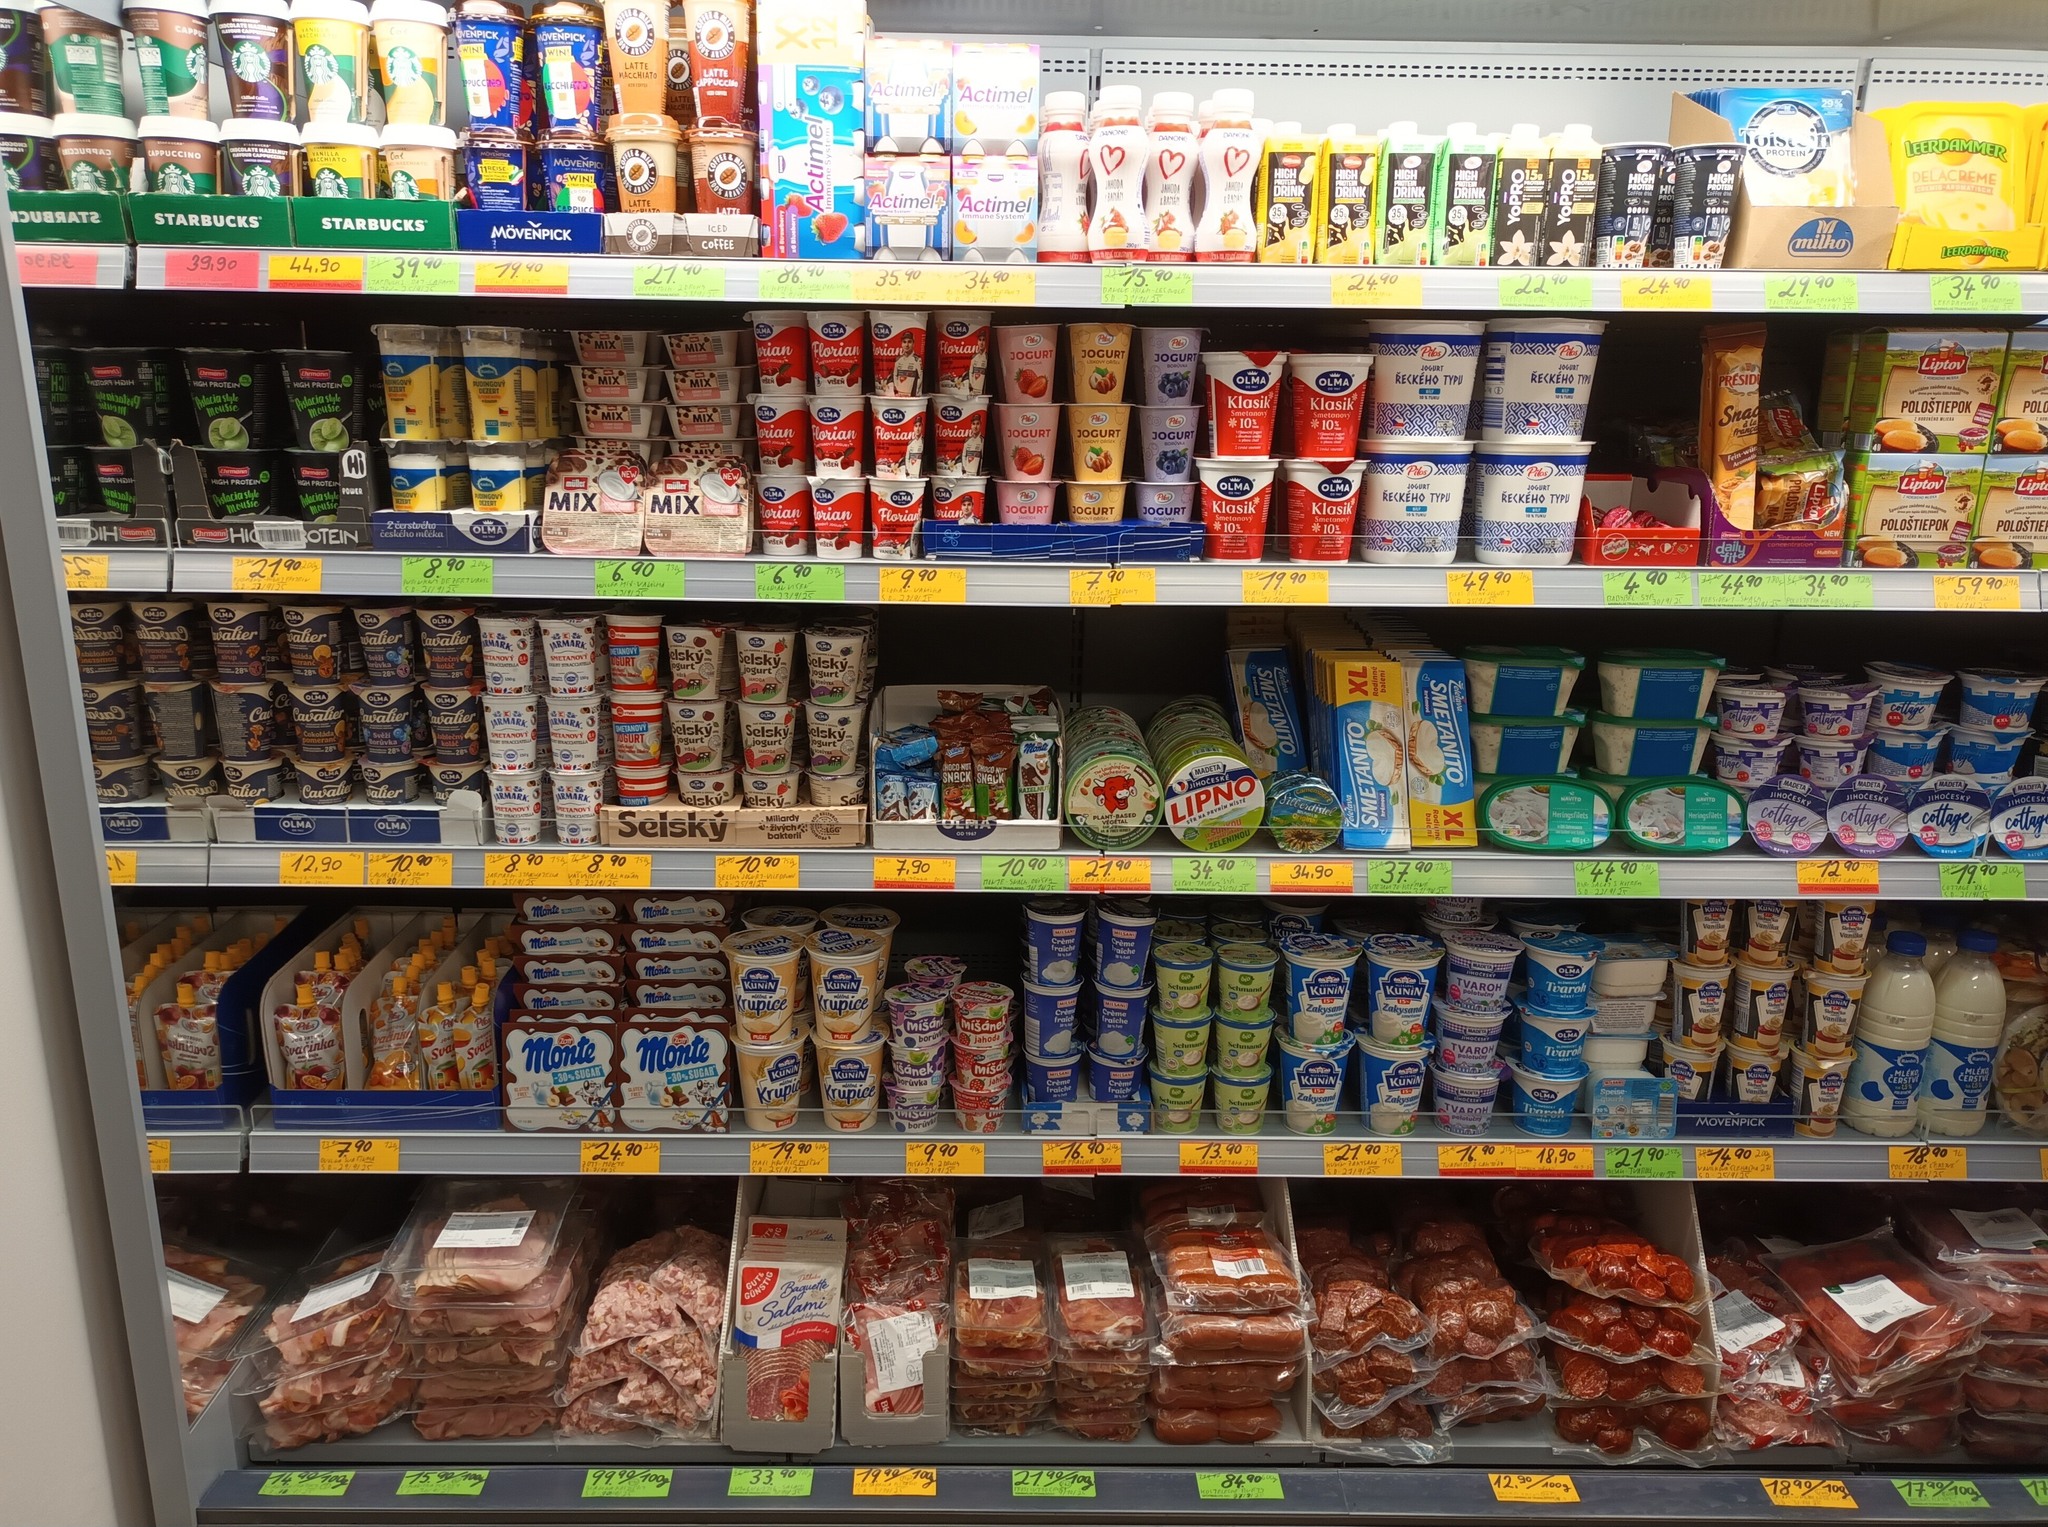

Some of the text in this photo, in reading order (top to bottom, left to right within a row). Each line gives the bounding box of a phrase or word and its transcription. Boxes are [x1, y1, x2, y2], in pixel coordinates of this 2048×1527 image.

[625, 62, 648, 71] LATTE
[703, 68, 729, 79] LATTE
[960, 86, 1033, 103] Actimel
[147, 149, 202, 161] CAPPUCCINO
[1766, 150, 1806, 158] PROTEIN
[1904, 139, 2008, 162] LEERDAMMER
[804, 115, 824, 212] Actimel
[568, 174, 594, 185] WIN!
[1274, 168, 1297, 180] HIGH
[1395, 169, 1417, 181] HIGH
[1628, 173, 1655, 184] HIGH
[1912, 170, 1998, 186] DELACREME
[1273, 185, 1305, 197] DRINK
[1393, 187, 1425, 198] DRINK
[959, 197, 1032, 213] Actimel
[154, 213, 260, 228] STARBUCKS
[321, 217, 425, 232] STARBUCKS
[491, 221, 572, 241] MÖVENPICK
[707, 224, 728, 234] ICED
[701, 238, 735, 251] COFFEE
[1791, 233, 1847, 251] milko
[1941, 245, 2009, 261] LEERDAMMER
[822, 326, 846, 335] OLMA
[1009, 349, 1053, 361] JOGURT
[1081, 349, 1126, 360] JOGURT
[1154, 353, 1197, 363] JOGURT
[1921, 357, 1966, 371] Liptov
[193, 380, 241, 389] HIGH PROTEIN
[1235, 376, 1267, 386] OLMA
[1443, 375, 1464, 387] TYPU
[1227, 395, 1271, 410] Klasik
[1900, 397, 1973, 414] POLOŠTIEPOK
[620, 471, 638, 480] NEW
[1900, 478, 1944, 491] Liptov
[342, 488, 363, 496] POWER
[548, 491, 599, 512] MIX
[1212, 501, 1257, 515] Klasik
[472, 524, 508, 536] OLMA
[1880, 516, 1949, 532] POLOŠTIEPOK
[1715, 540, 1747, 556] daily
[1722, 552, 1739, 563] fit
[421, 631, 472, 647] Cavalier
[743, 665, 772, 676] jogurt
[1348, 665, 1369, 697] XL
[305, 693, 327, 702] OLMA
[293, 705, 345, 723] Cavalier
[1429, 679, 1464, 790] SMETANITO
[1194, 763, 1222, 776] MADETA
[1346, 721, 1380, 829] SMETANITO
[942, 772, 972, 784] SNACK
[1938, 780, 1963, 790] MADETA
[1169, 775, 1256, 825] LIPNO
[765, 815, 800, 823] Miliardy
[1551, 811, 1589, 821] Heringsfilets
[1922, 804, 1973, 836] cottage
[281, 819, 313, 830] OLMA
[769, 823, 797, 833] živých
[1111, 939, 1135, 948] Crème
[1168, 982, 1203, 992] Schmand
[1456, 978, 1504, 992] TVAROH
[521, 1036, 597, 1074] Monte
[574, 1067, 602, 1081] SUGAR
[1695, 1111, 1766, 1128] MÖVENPICK
[757, 1297, 829, 1328] Salami
